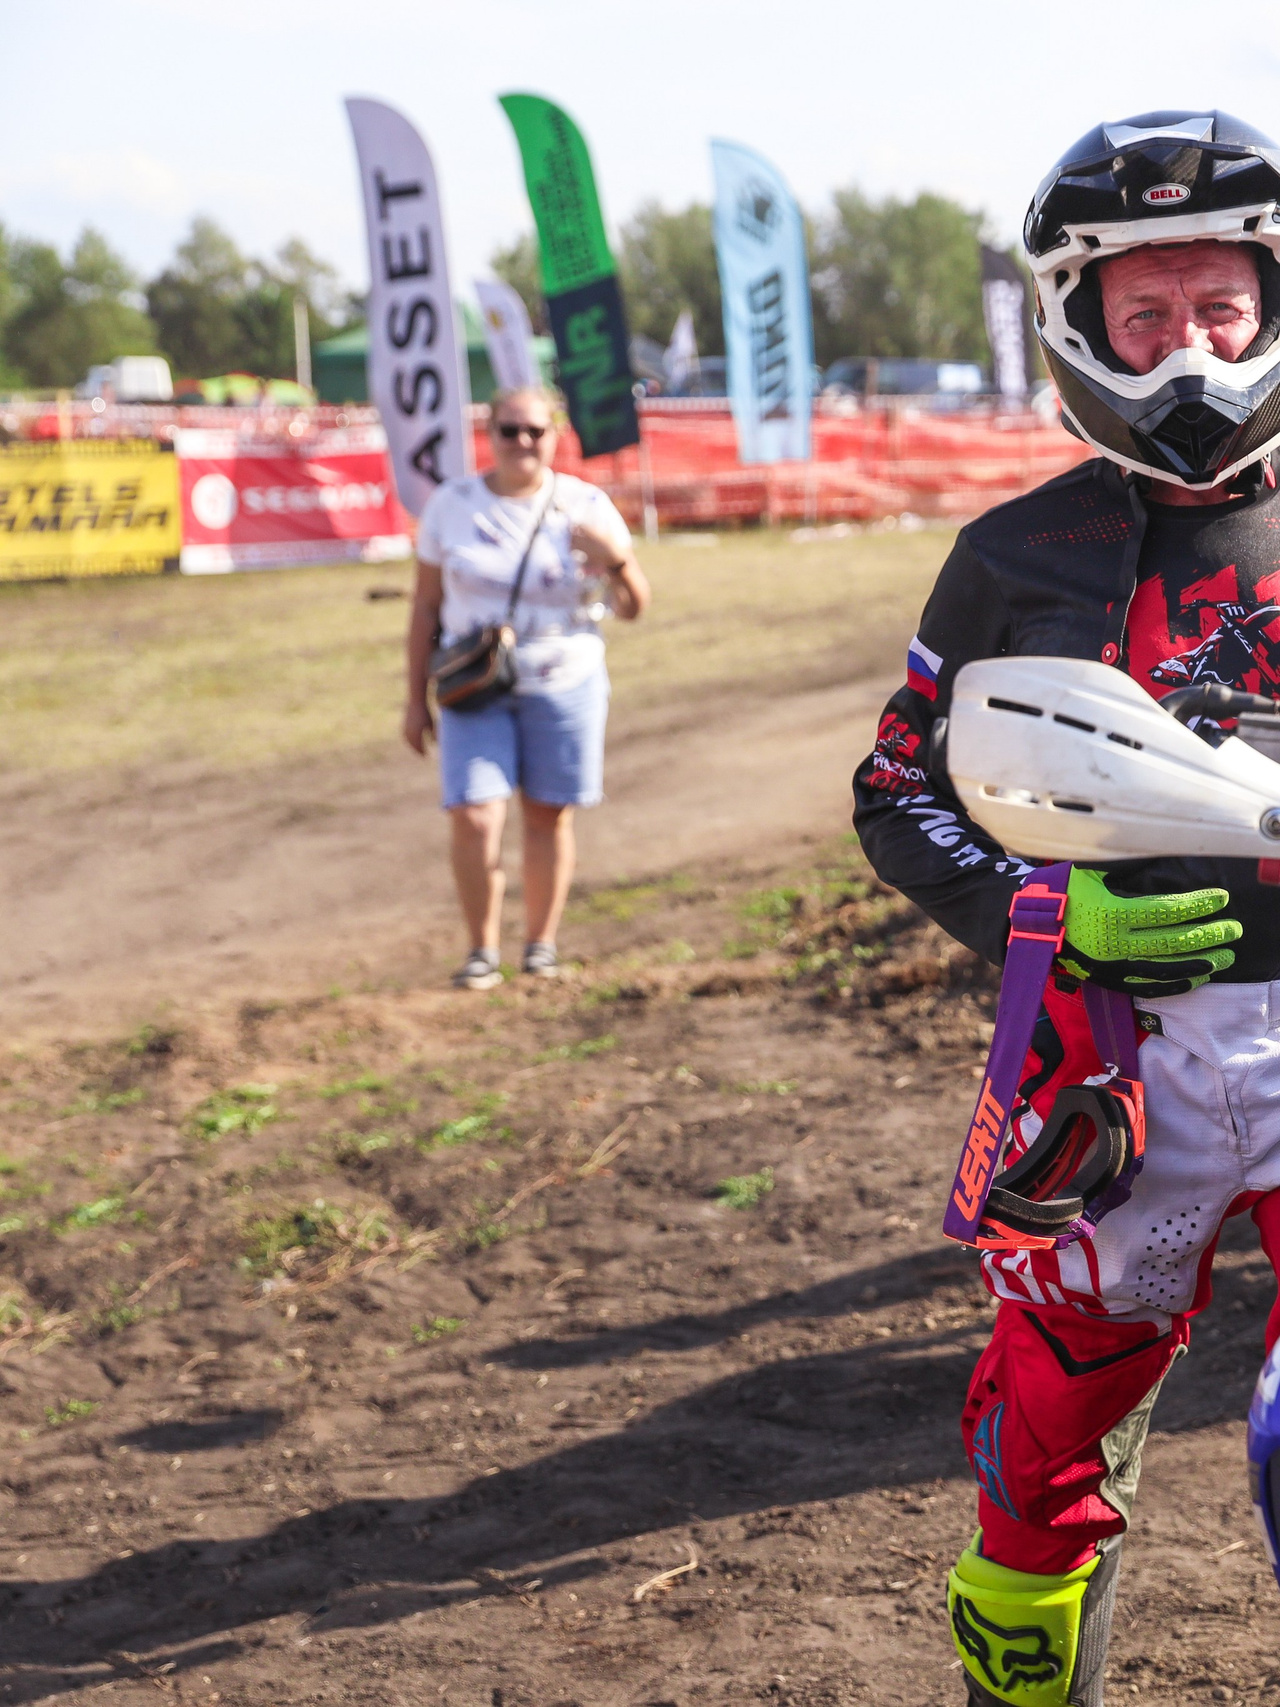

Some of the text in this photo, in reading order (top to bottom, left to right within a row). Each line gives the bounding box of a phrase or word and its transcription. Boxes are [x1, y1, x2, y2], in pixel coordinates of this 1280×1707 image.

[1150, 189, 1183, 200] BELL
[374, 166, 446, 487] ASSET
[1226, 606, 1245, 616] 111
